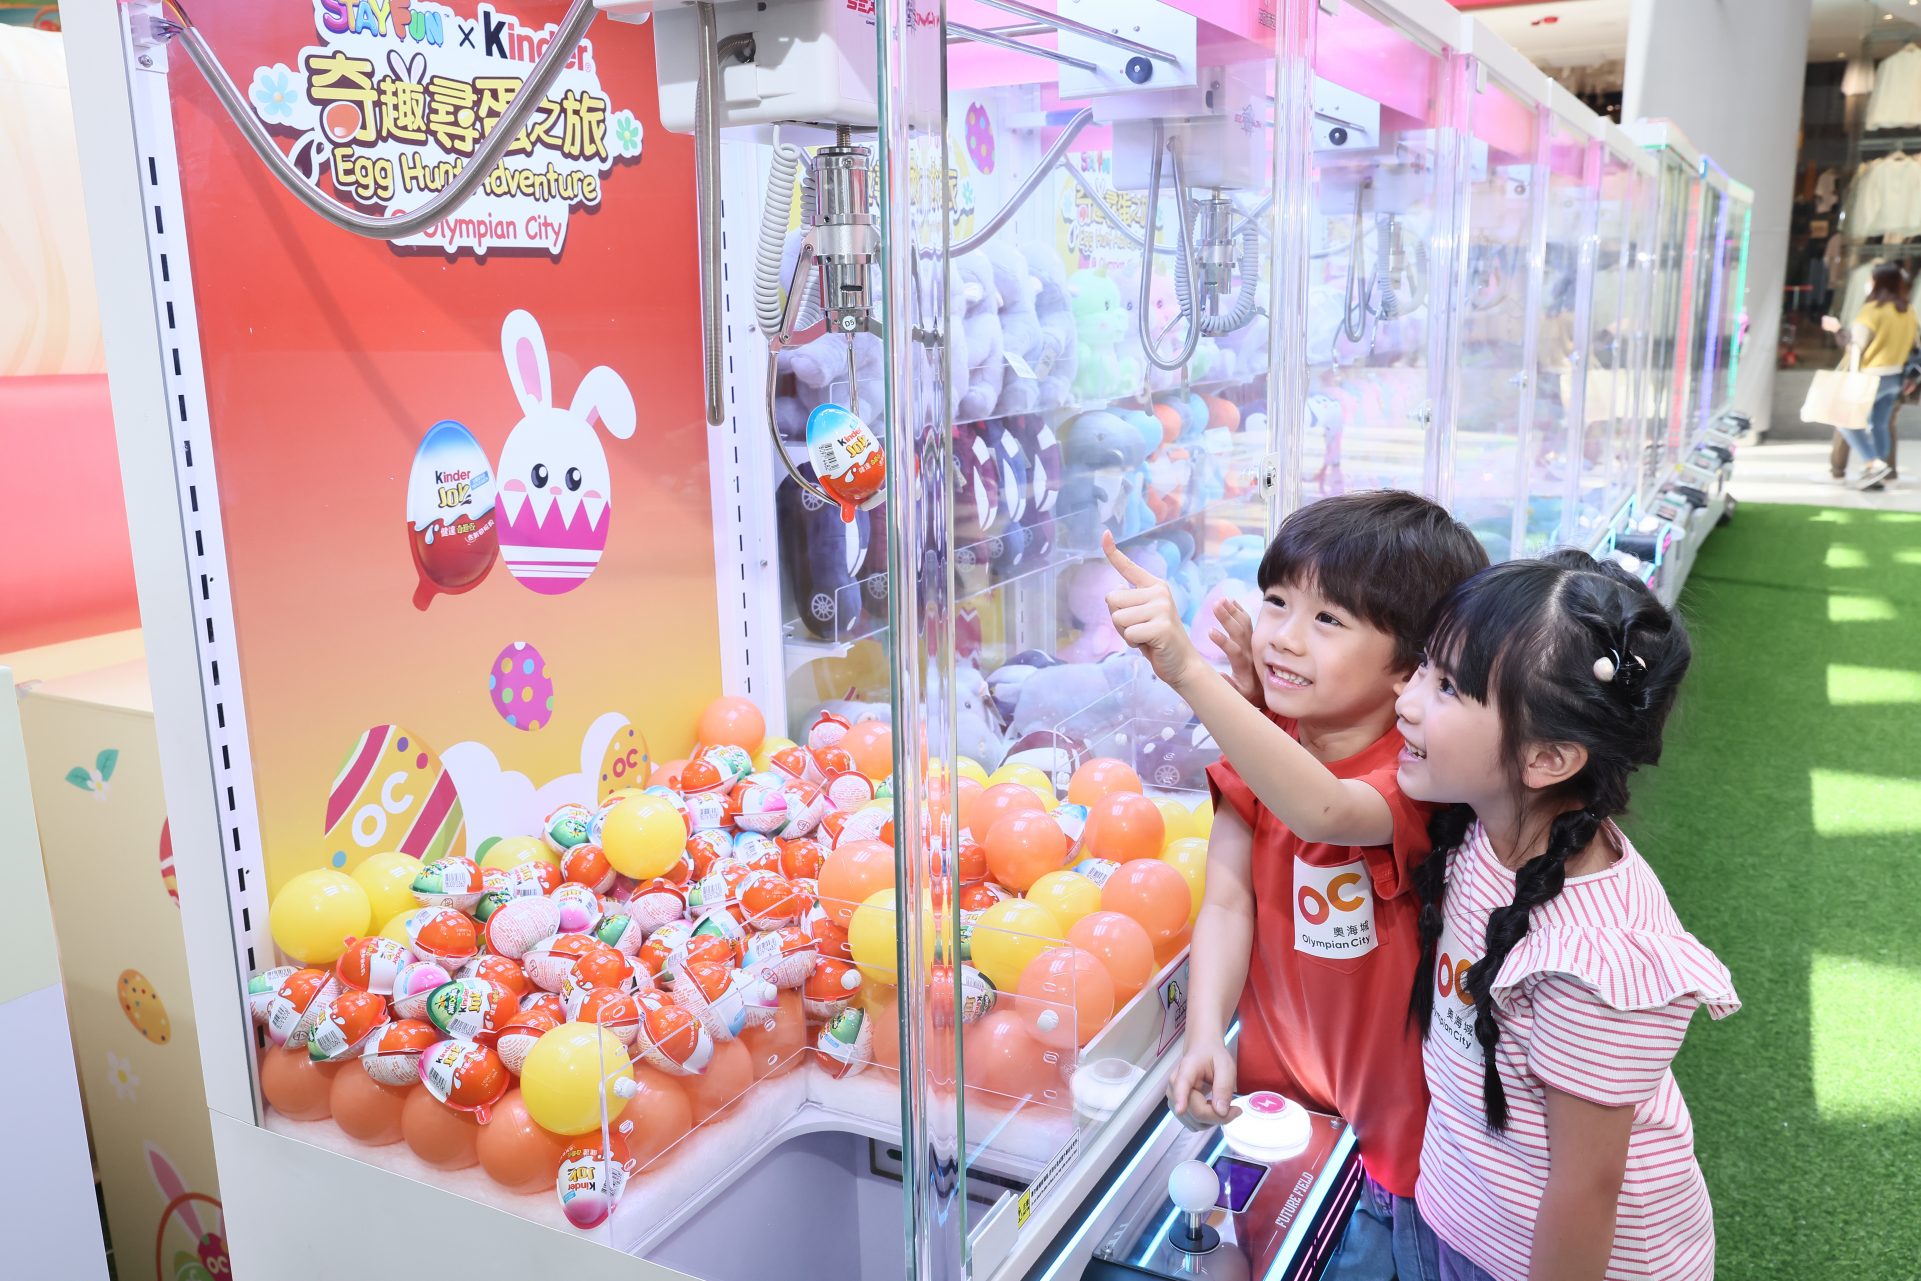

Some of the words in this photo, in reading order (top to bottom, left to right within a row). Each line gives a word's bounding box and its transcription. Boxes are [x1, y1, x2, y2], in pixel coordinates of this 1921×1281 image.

[483, 10, 588, 71] Kindr
[333, 146, 394, 202] Egg
[482, 157, 599, 201] dventure
[525, 214, 562, 248] City
[434, 469, 471, 485] Kinder
[612, 748, 639, 778] OC
[351, 771, 415, 848] OC
[1297, 872, 1366, 926] OC
[1302, 934, 1350, 951] Olympian
[1350, 935, 1370, 948] City
[1453, 1030, 1472, 1049] City
[567, 1181, 596, 1192] Kinder
[1275, 1193, 1302, 1229] FUTURE
[1292, 1171, 1314, 1197] FIELD
[206, 1255, 230, 1275] OC
